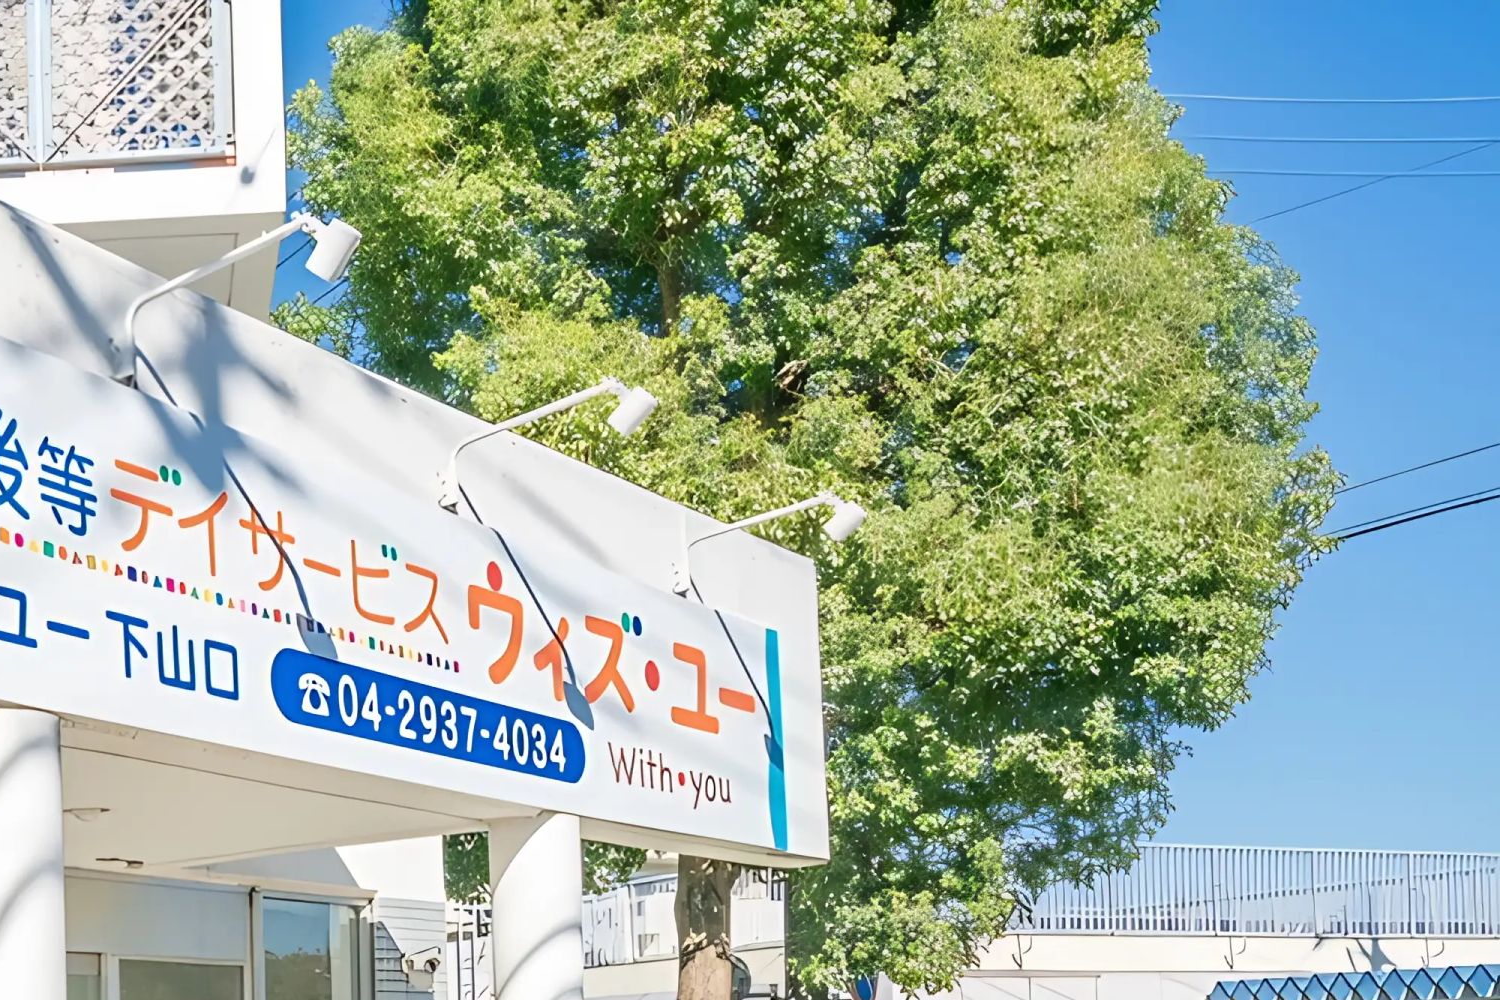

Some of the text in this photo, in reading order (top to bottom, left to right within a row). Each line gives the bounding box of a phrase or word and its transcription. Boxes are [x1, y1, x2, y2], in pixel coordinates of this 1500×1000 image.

[468, 561, 756, 734] ウィズ・ユー
[338, 674, 567, 774] 04-2937-4034
